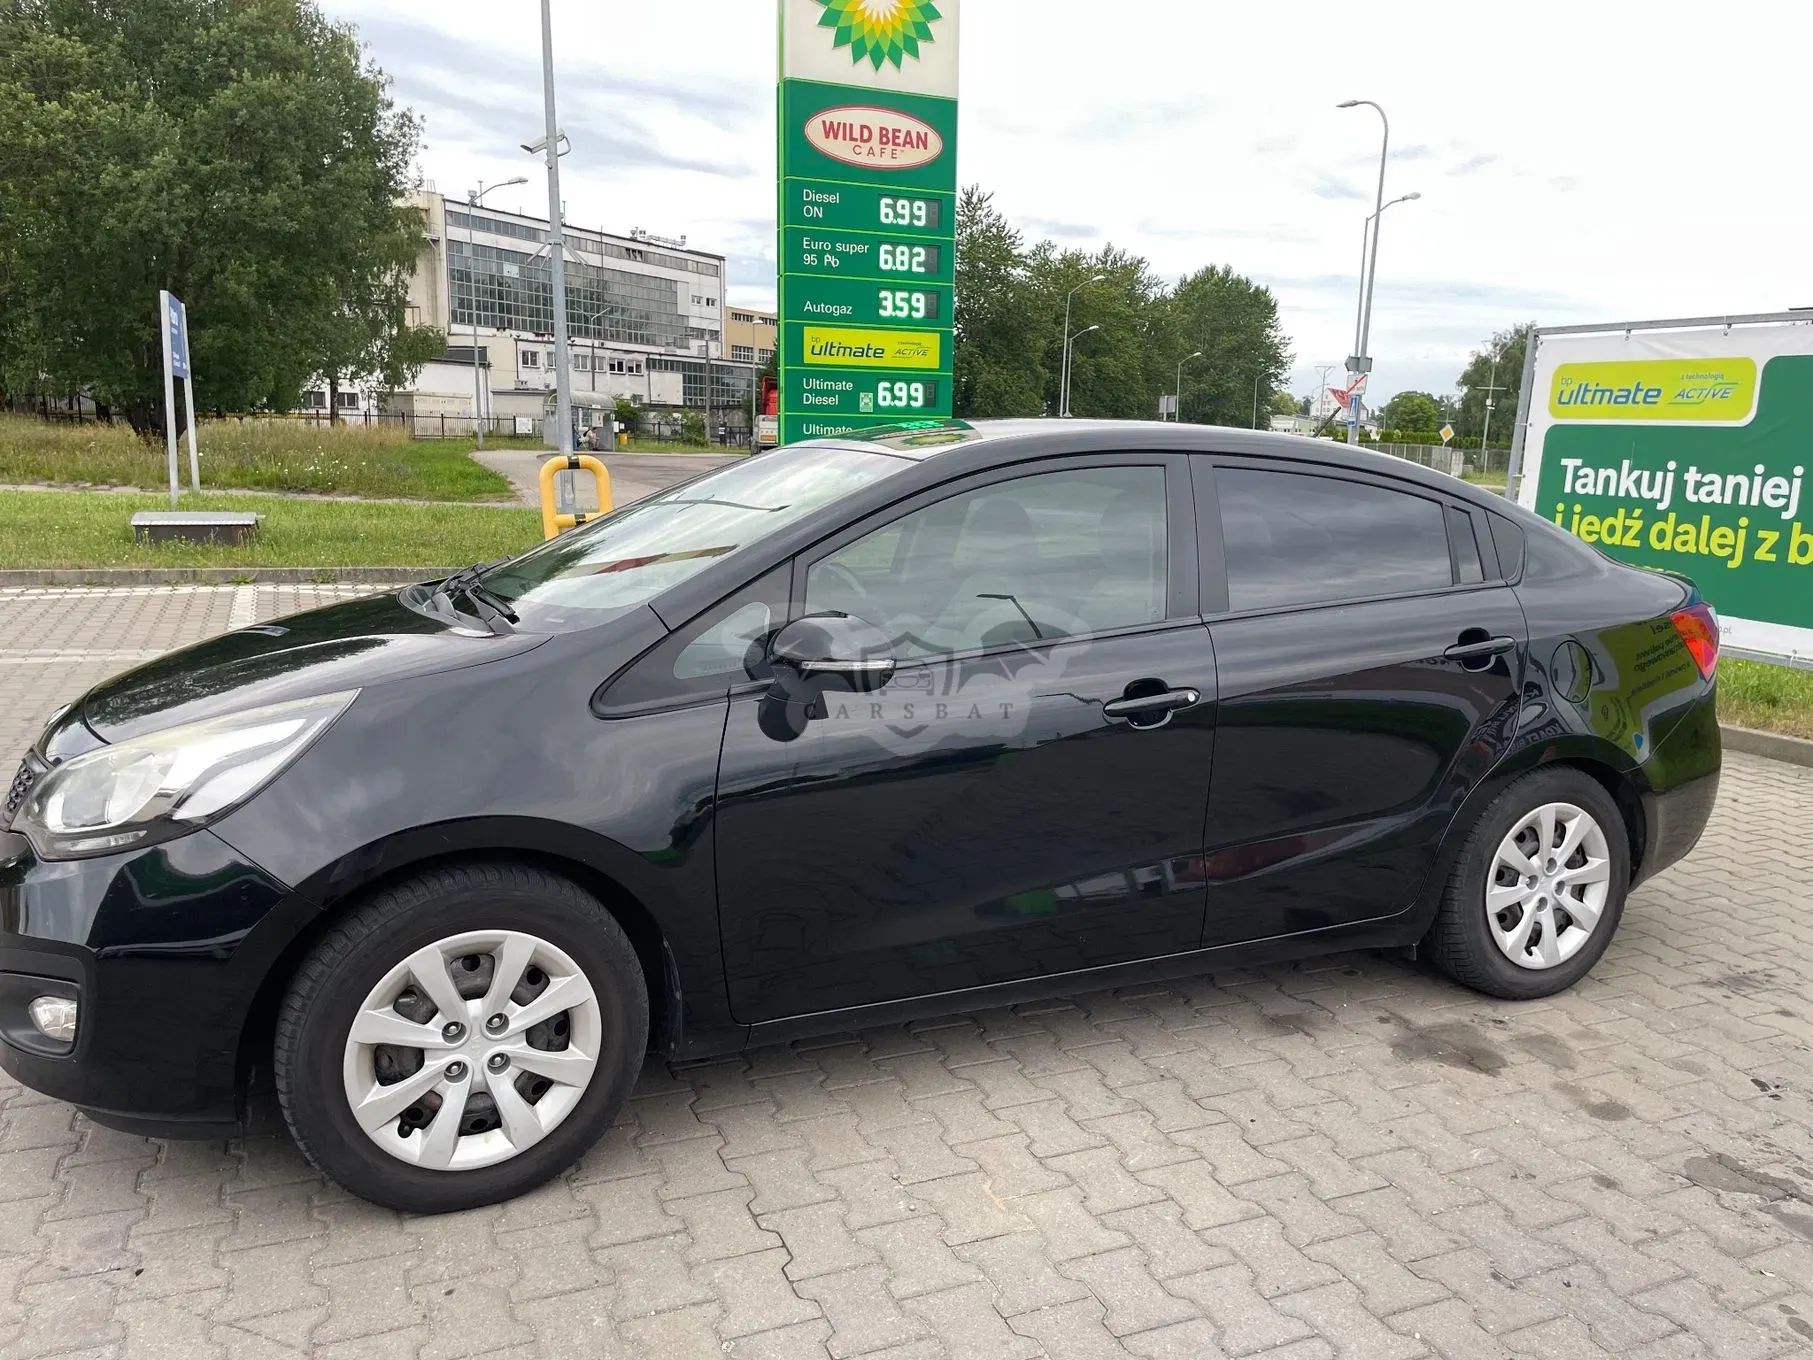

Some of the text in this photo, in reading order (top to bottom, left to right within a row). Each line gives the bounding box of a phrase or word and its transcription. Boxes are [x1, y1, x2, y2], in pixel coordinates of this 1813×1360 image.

[822, 120, 928, 150] WILD BEAN
[852, 144, 898, 159] CAFE
[803, 189, 840, 204] Diesel
[803, 205, 823, 218] ON
[879, 197, 927, 227] 6.99
[803, 237, 869, 254] Euro super
[803, 254, 818, 266] 95
[878, 244, 926, 273] 6.82
[803, 301, 853, 316] Autogaz
[878, 290, 926, 318] 3.59
[811, 341, 885, 358] ultimate
[894, 348, 929, 356] ACTIVE
[803, 377, 853, 391] Ultimate
[803, 394, 839, 405] Diesel
[877, 381, 924, 408] 6.99
[1558, 381, 1662, 405] ultimate
[1674, 387, 1735, 399] ACTIVE
[1560, 458, 1804, 520] Tankuj taniej
[1571, 503, 1643, 548] jedź
[1649, 512, 1749, 568] dalej
[1754, 530, 1780, 562] z
